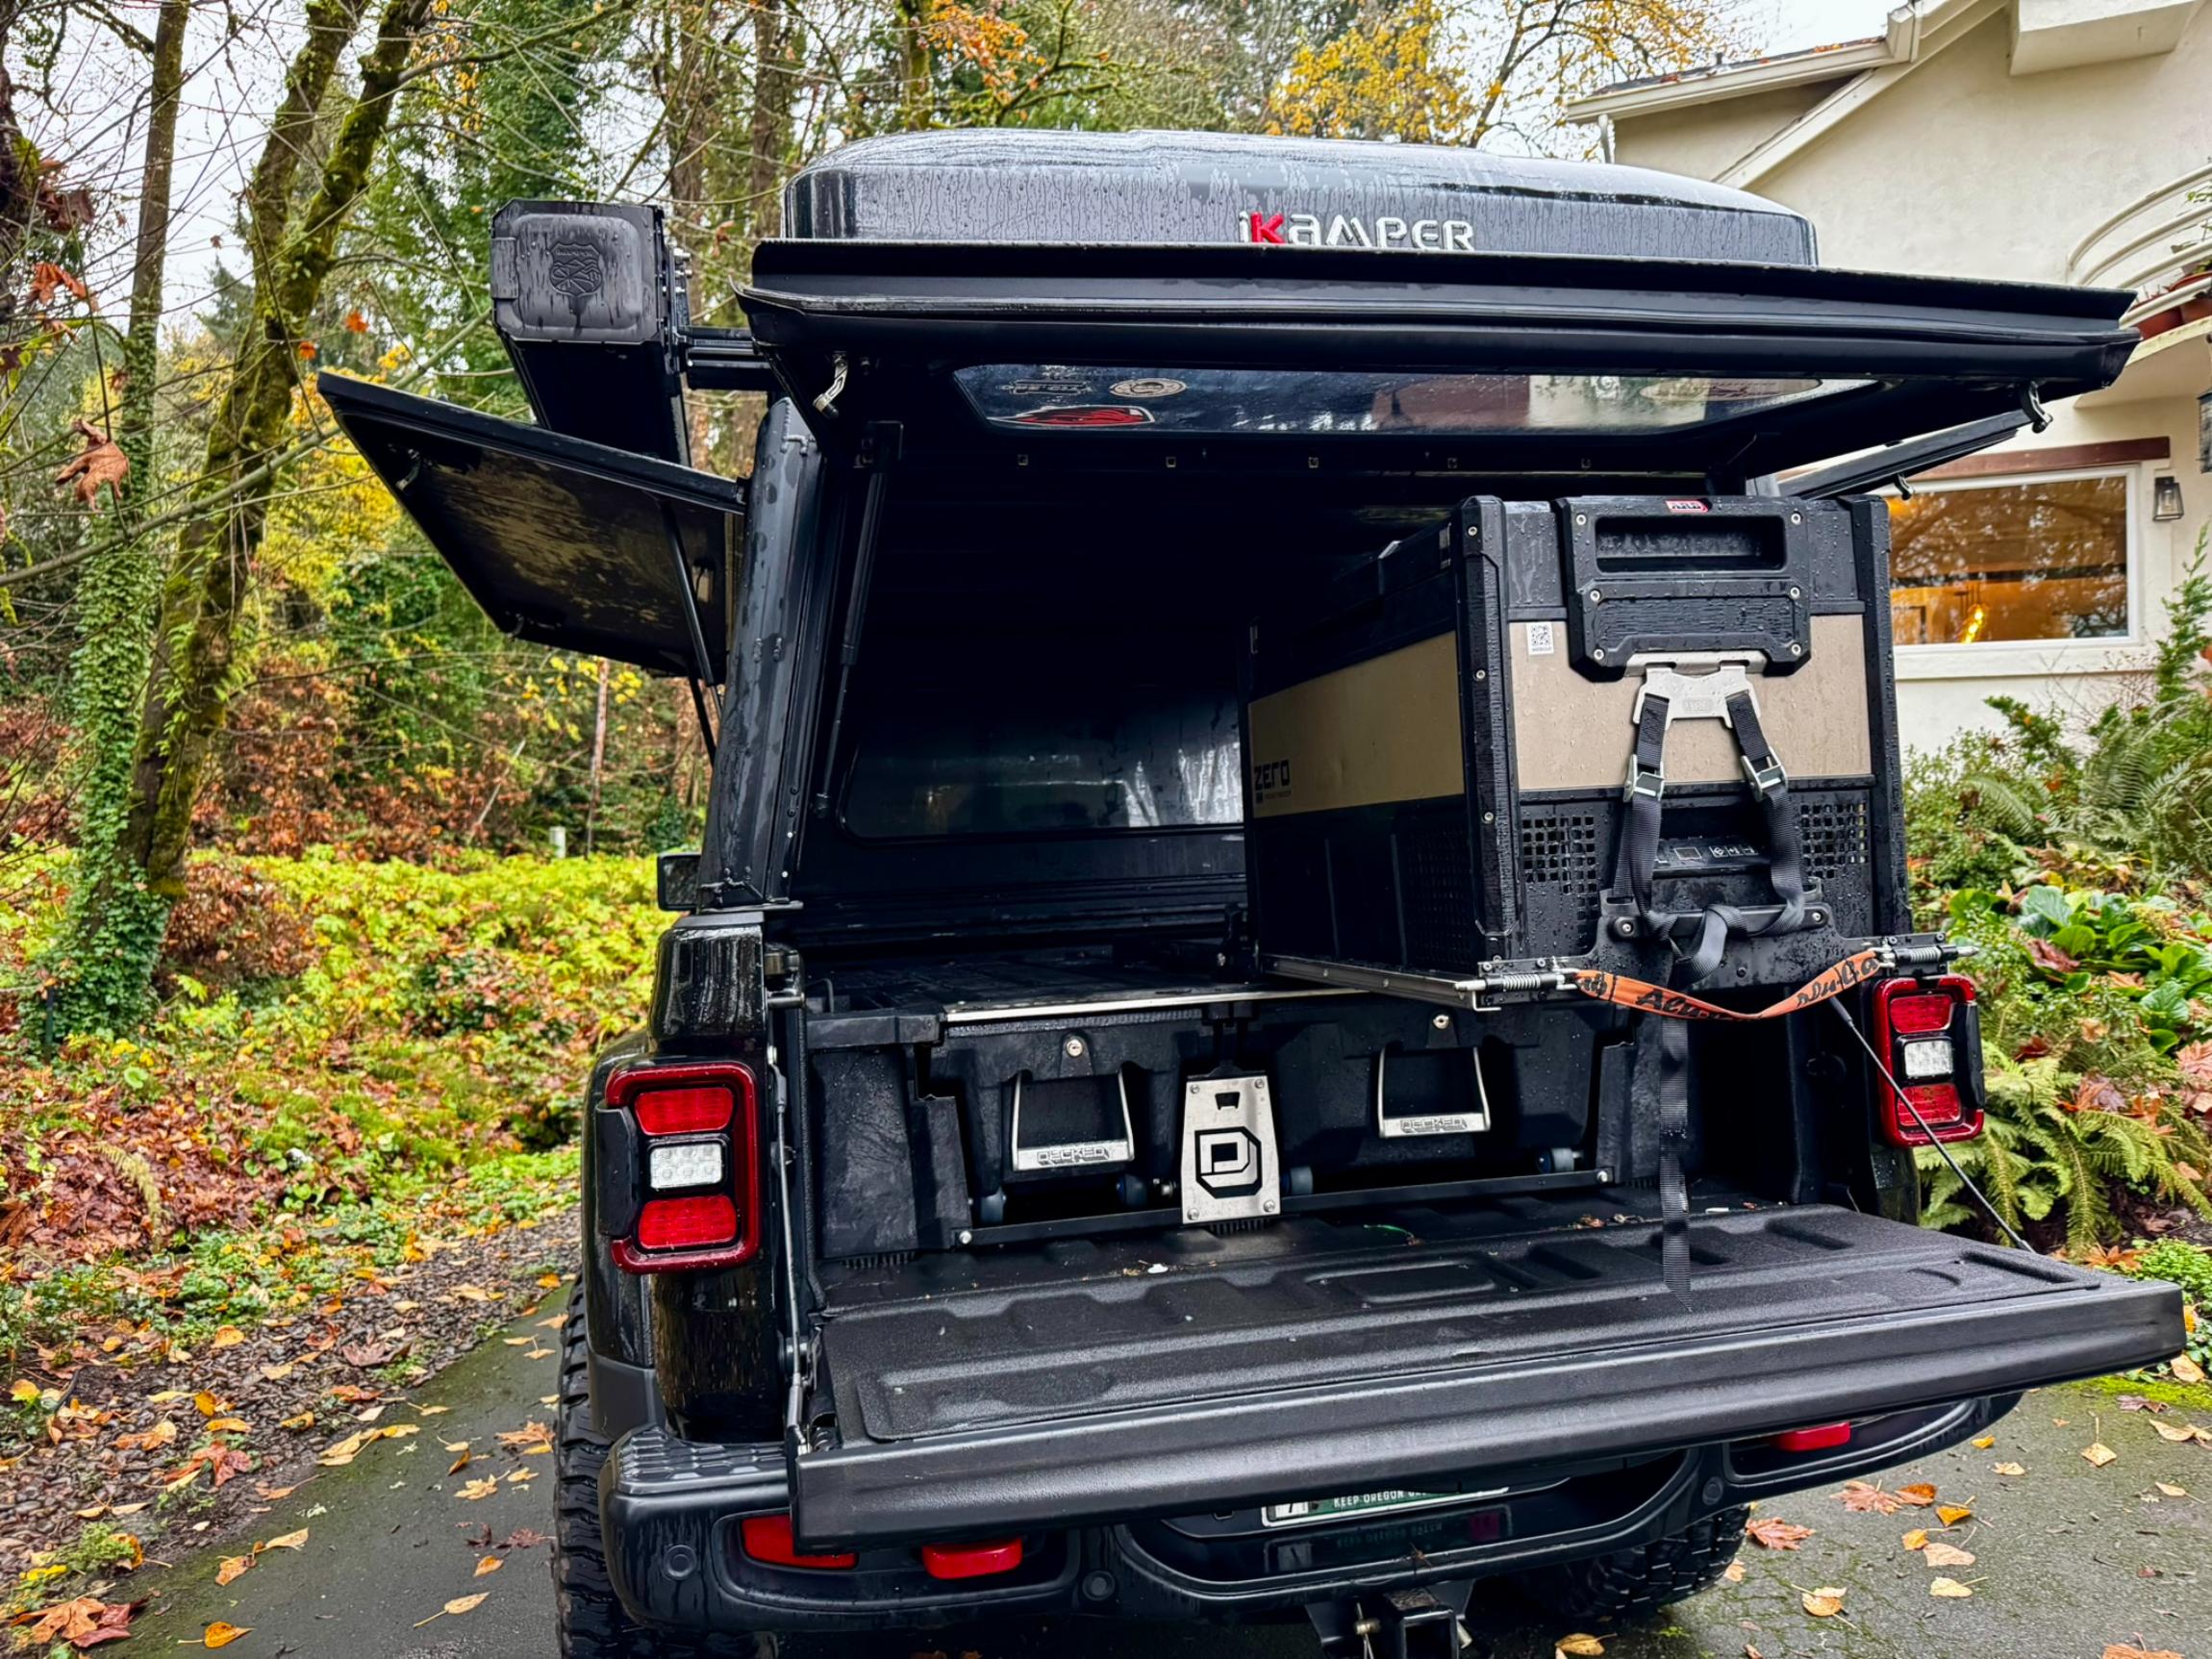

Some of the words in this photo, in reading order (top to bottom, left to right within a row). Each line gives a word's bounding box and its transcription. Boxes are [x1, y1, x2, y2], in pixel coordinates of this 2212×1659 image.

[1400, 1118, 1468, 1134] DECKED
[1038, 1146, 1110, 1166] DECKED
[1333, 1496, 1360, 1508] KEEP
[1363, 1490, 1404, 1503] OREGON
